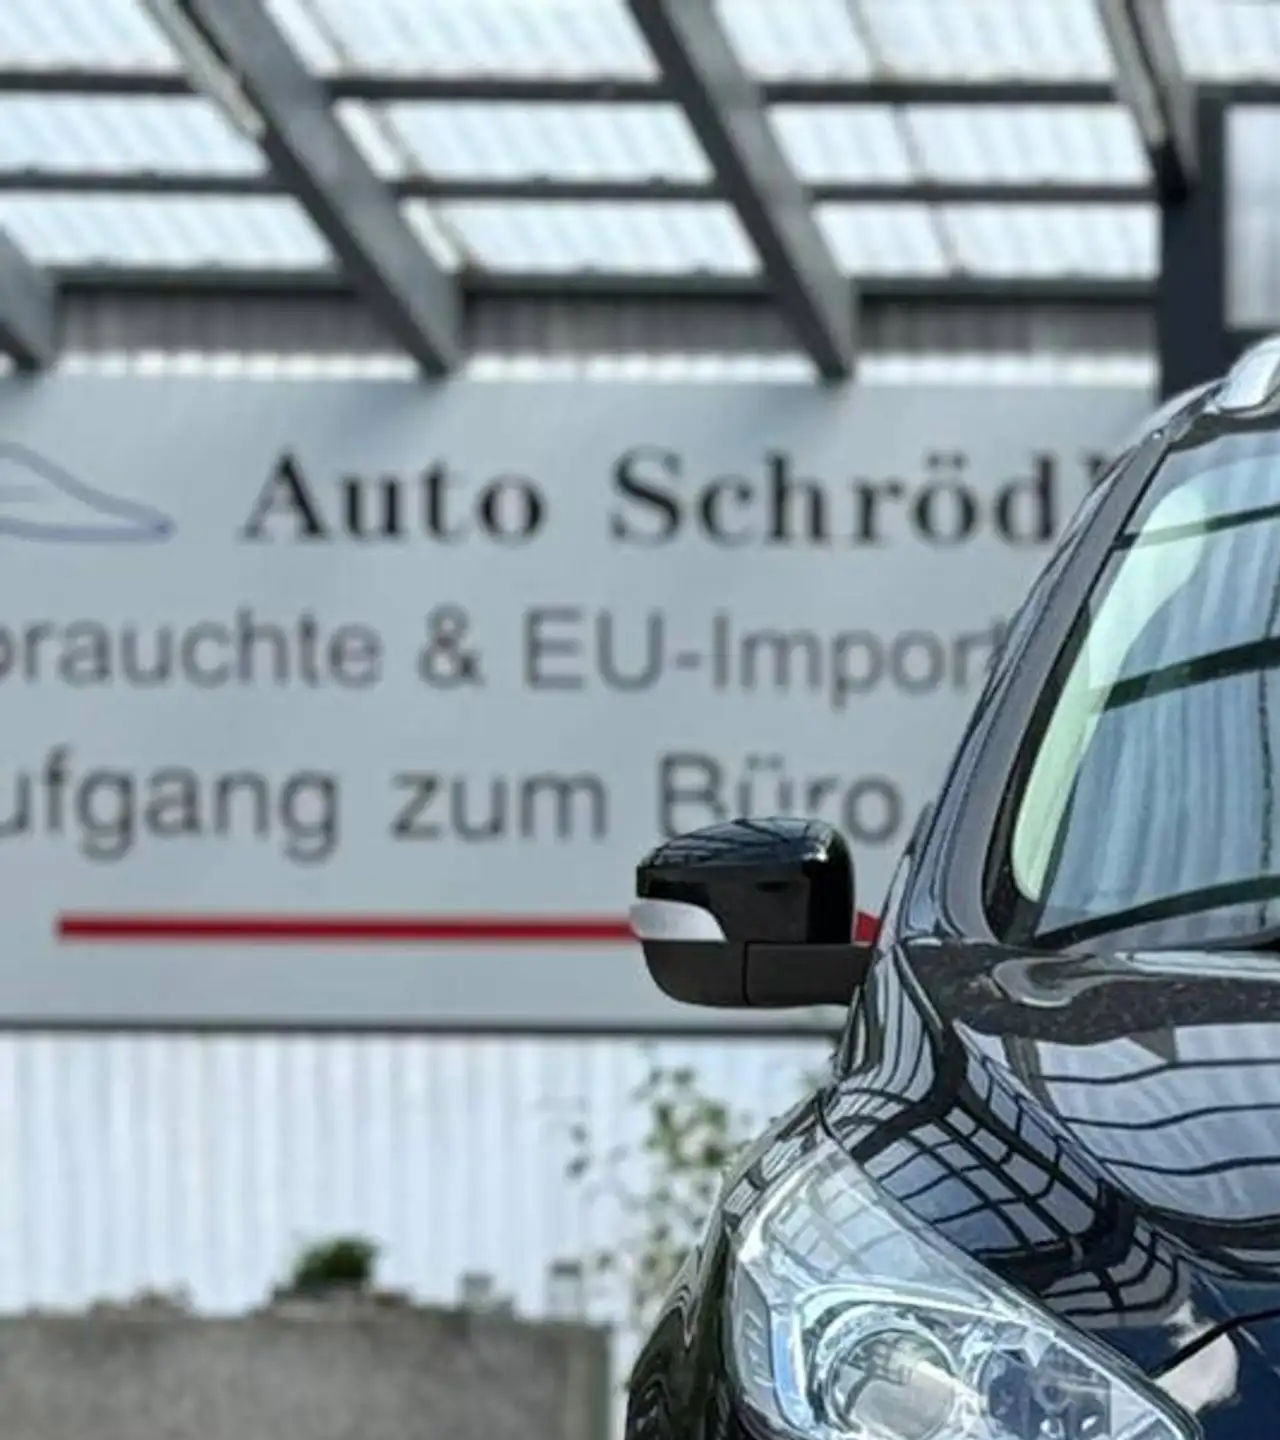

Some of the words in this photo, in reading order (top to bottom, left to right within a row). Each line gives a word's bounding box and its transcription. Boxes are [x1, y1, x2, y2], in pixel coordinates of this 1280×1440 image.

[242, 448, 547, 546] Auto
[416, 604, 486, 692] &
[390, 768, 611, 844] zum
[658, 750, 902, 844] Büro
